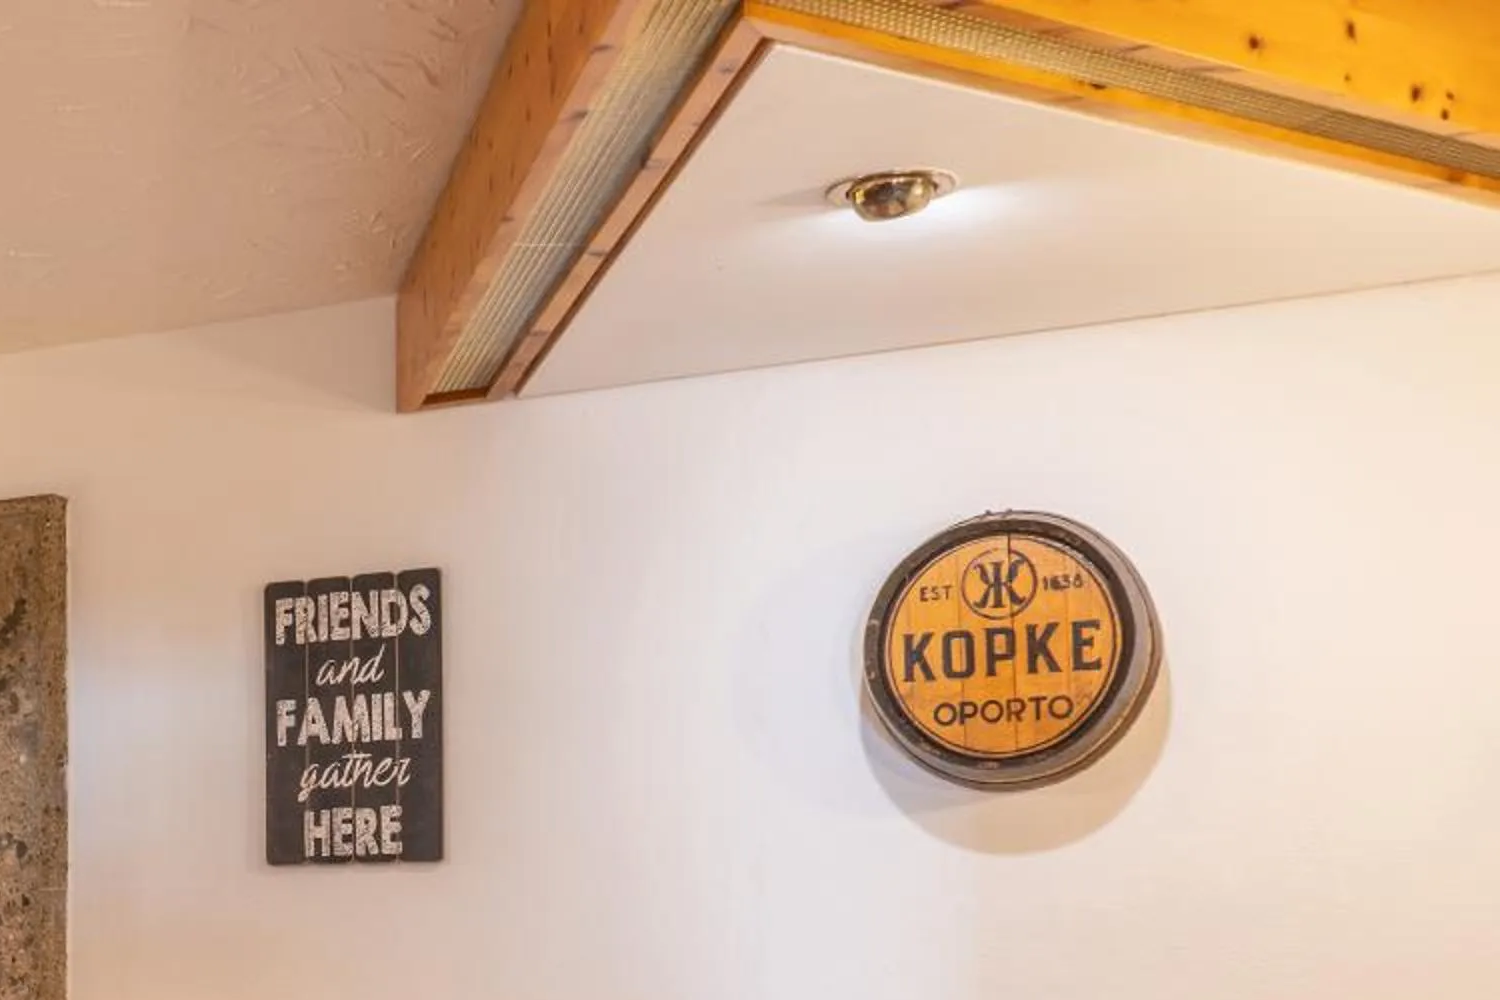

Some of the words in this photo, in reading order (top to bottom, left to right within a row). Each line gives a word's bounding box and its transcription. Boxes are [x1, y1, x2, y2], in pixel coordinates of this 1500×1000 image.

[274, 583, 432, 646] FRIENDS
[919, 585, 954, 603] EST
[315, 643, 386, 687] and
[901, 618, 1103, 684] KOPKE
[275, 689, 432, 748] FAMILY
[932, 694, 1074, 727] OPORTO
[297, 750, 412, 803] gather
[303, 804, 405, 858] HERE
